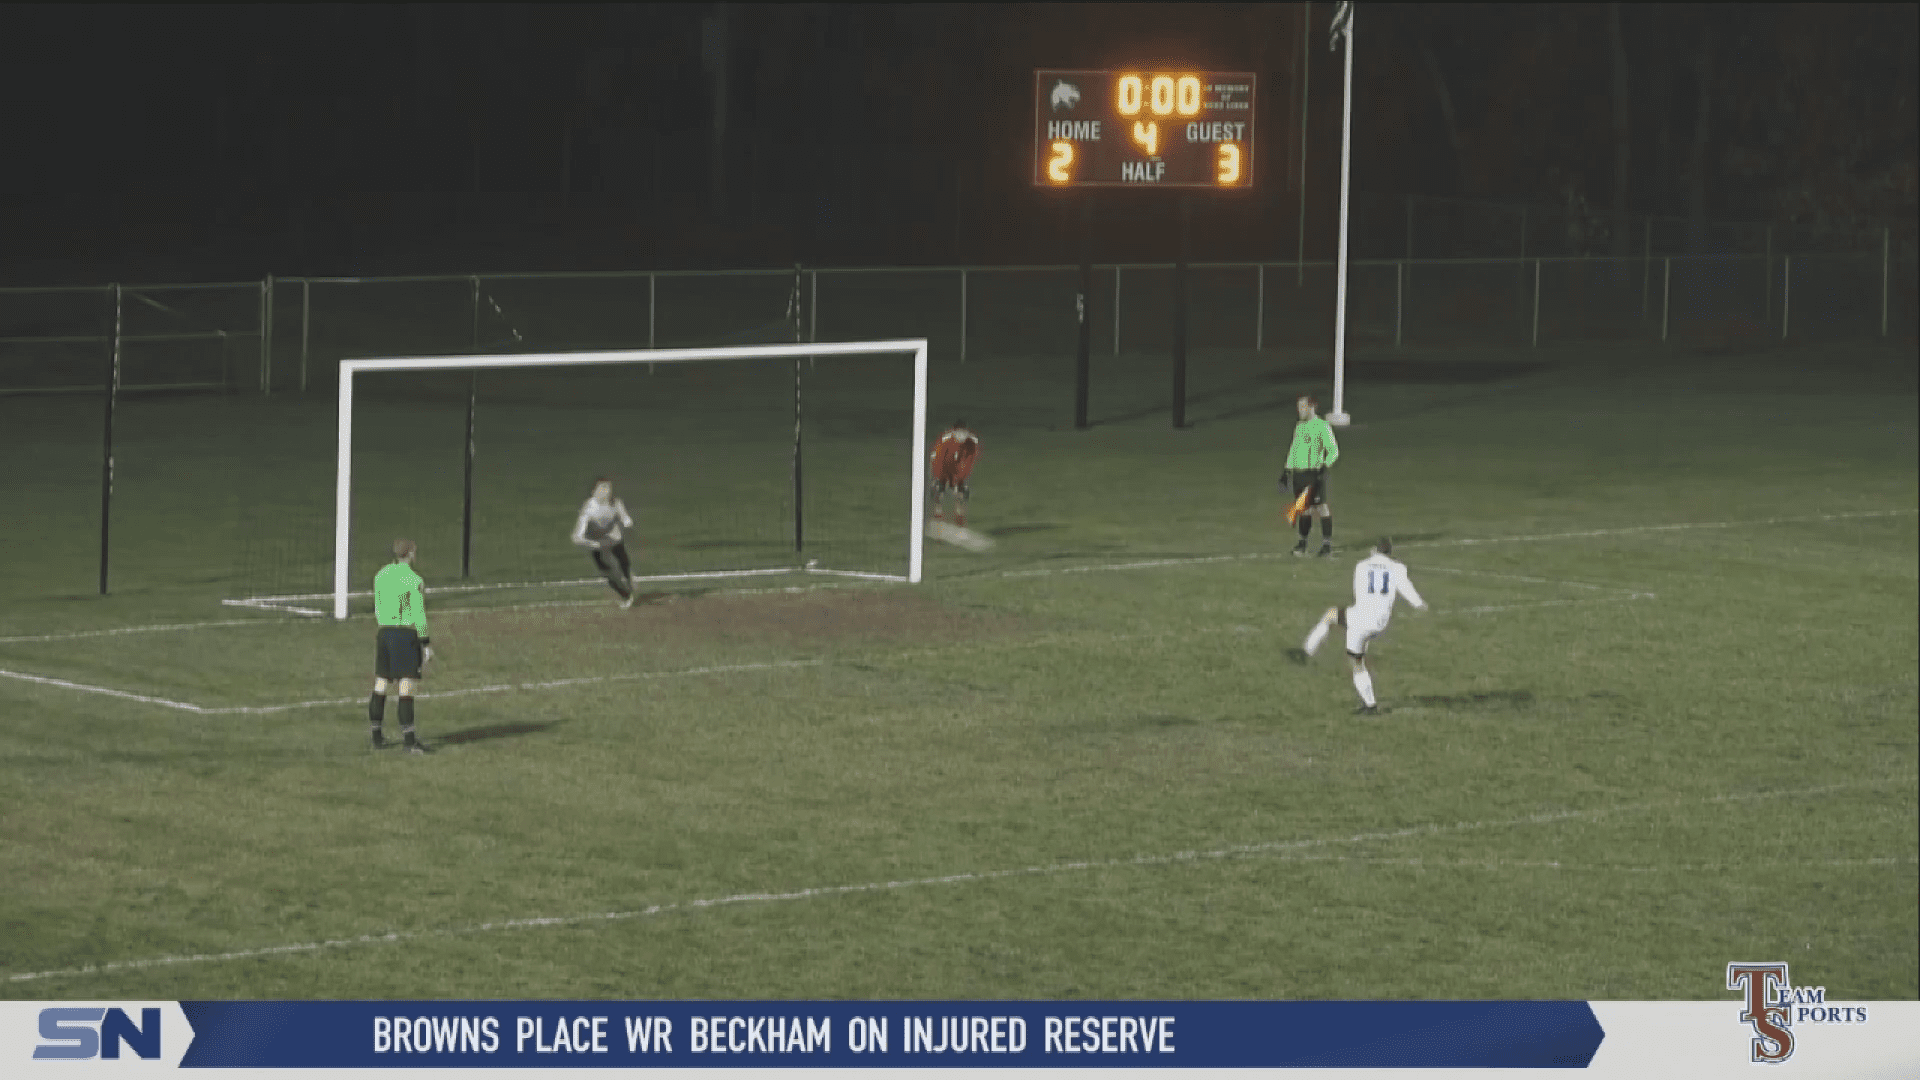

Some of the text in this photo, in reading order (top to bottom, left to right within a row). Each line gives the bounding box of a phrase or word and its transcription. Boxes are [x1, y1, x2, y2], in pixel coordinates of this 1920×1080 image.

[1117, 75, 1201, 116] 0:00
[1048, 120, 1102, 141] HOME
[1133, 120, 1158, 156] 4
[1185, 121, 1246, 142] GUEST
[1048, 141, 1074, 182] 2
[1121, 161, 1165, 183] HALF
[1217, 143, 1241, 184] 3
[1367, 570, 1390, 594] 11
